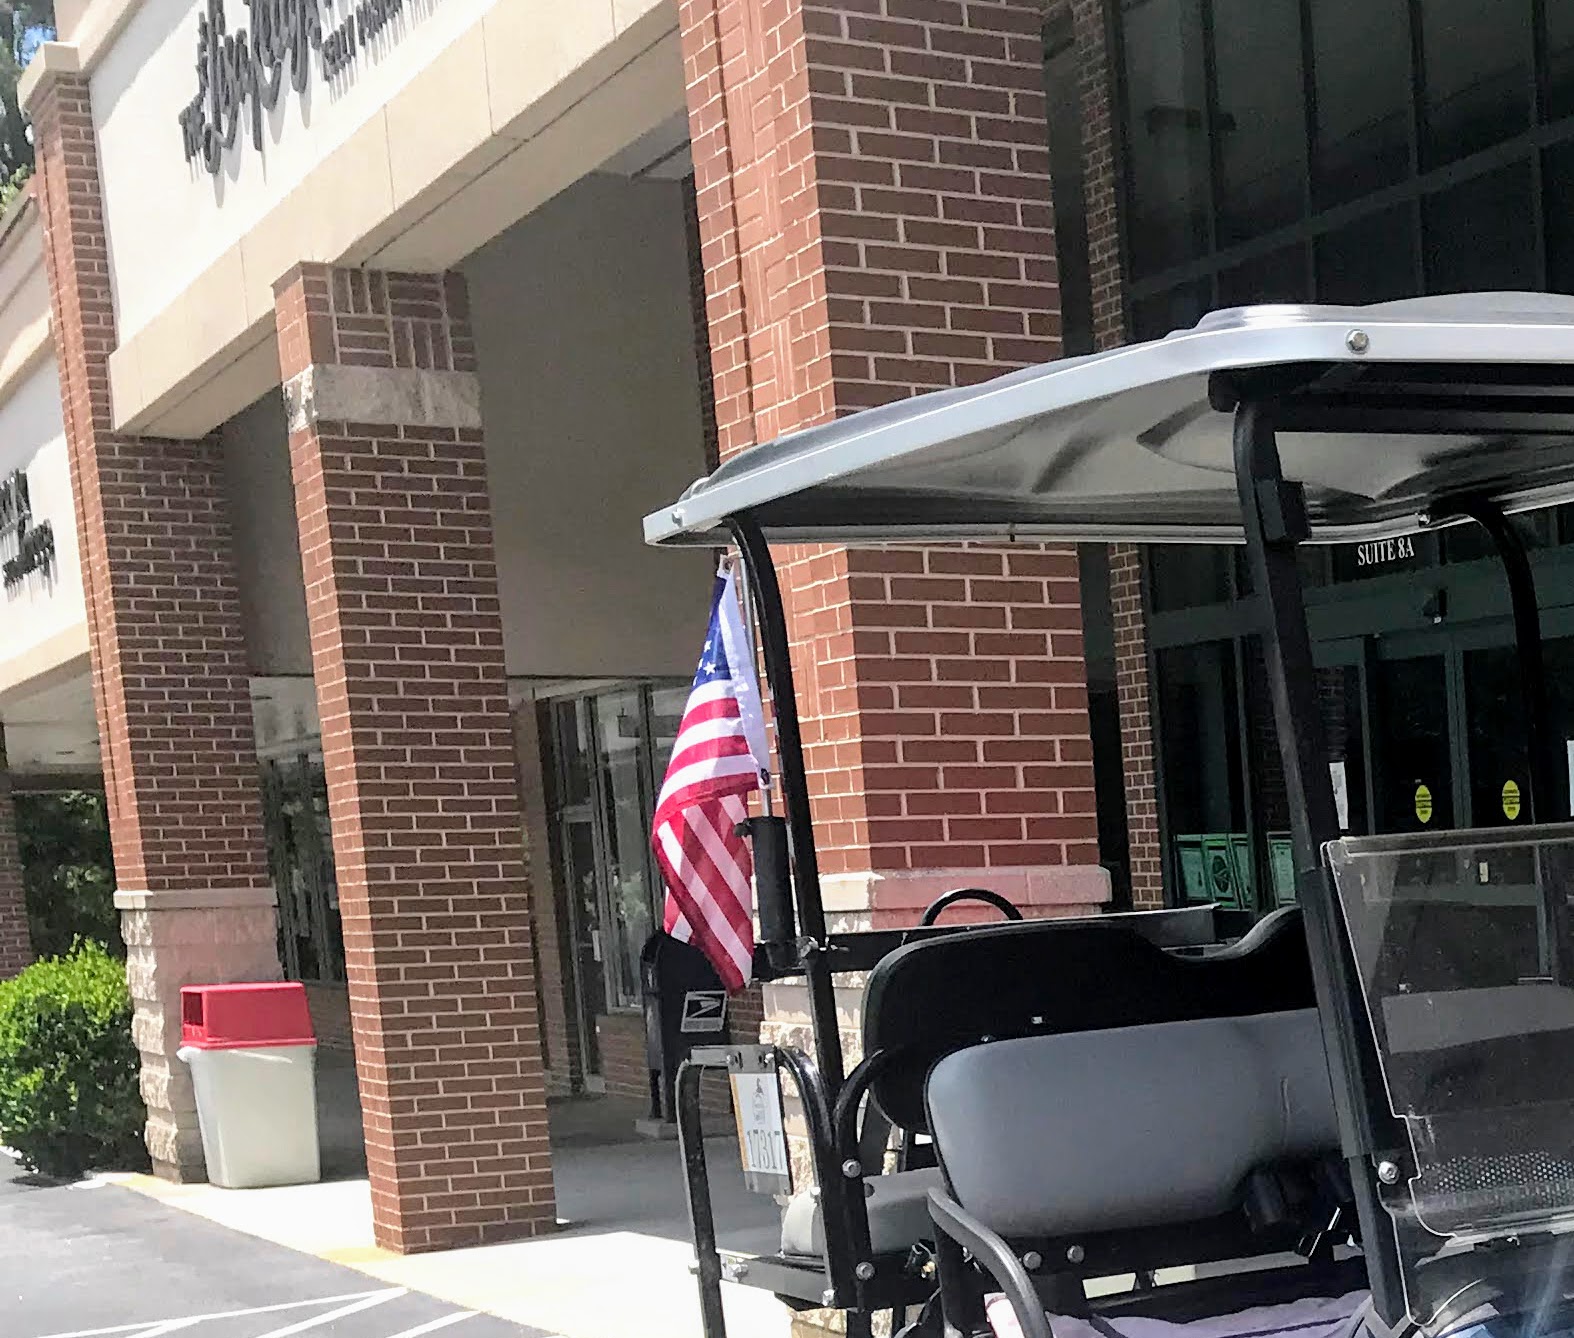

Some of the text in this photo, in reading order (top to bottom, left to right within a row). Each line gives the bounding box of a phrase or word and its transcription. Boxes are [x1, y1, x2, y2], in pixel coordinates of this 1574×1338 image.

[1357, 537, 1415, 566] SUITE 8A
[747, 1128, 784, 1170] 17317
